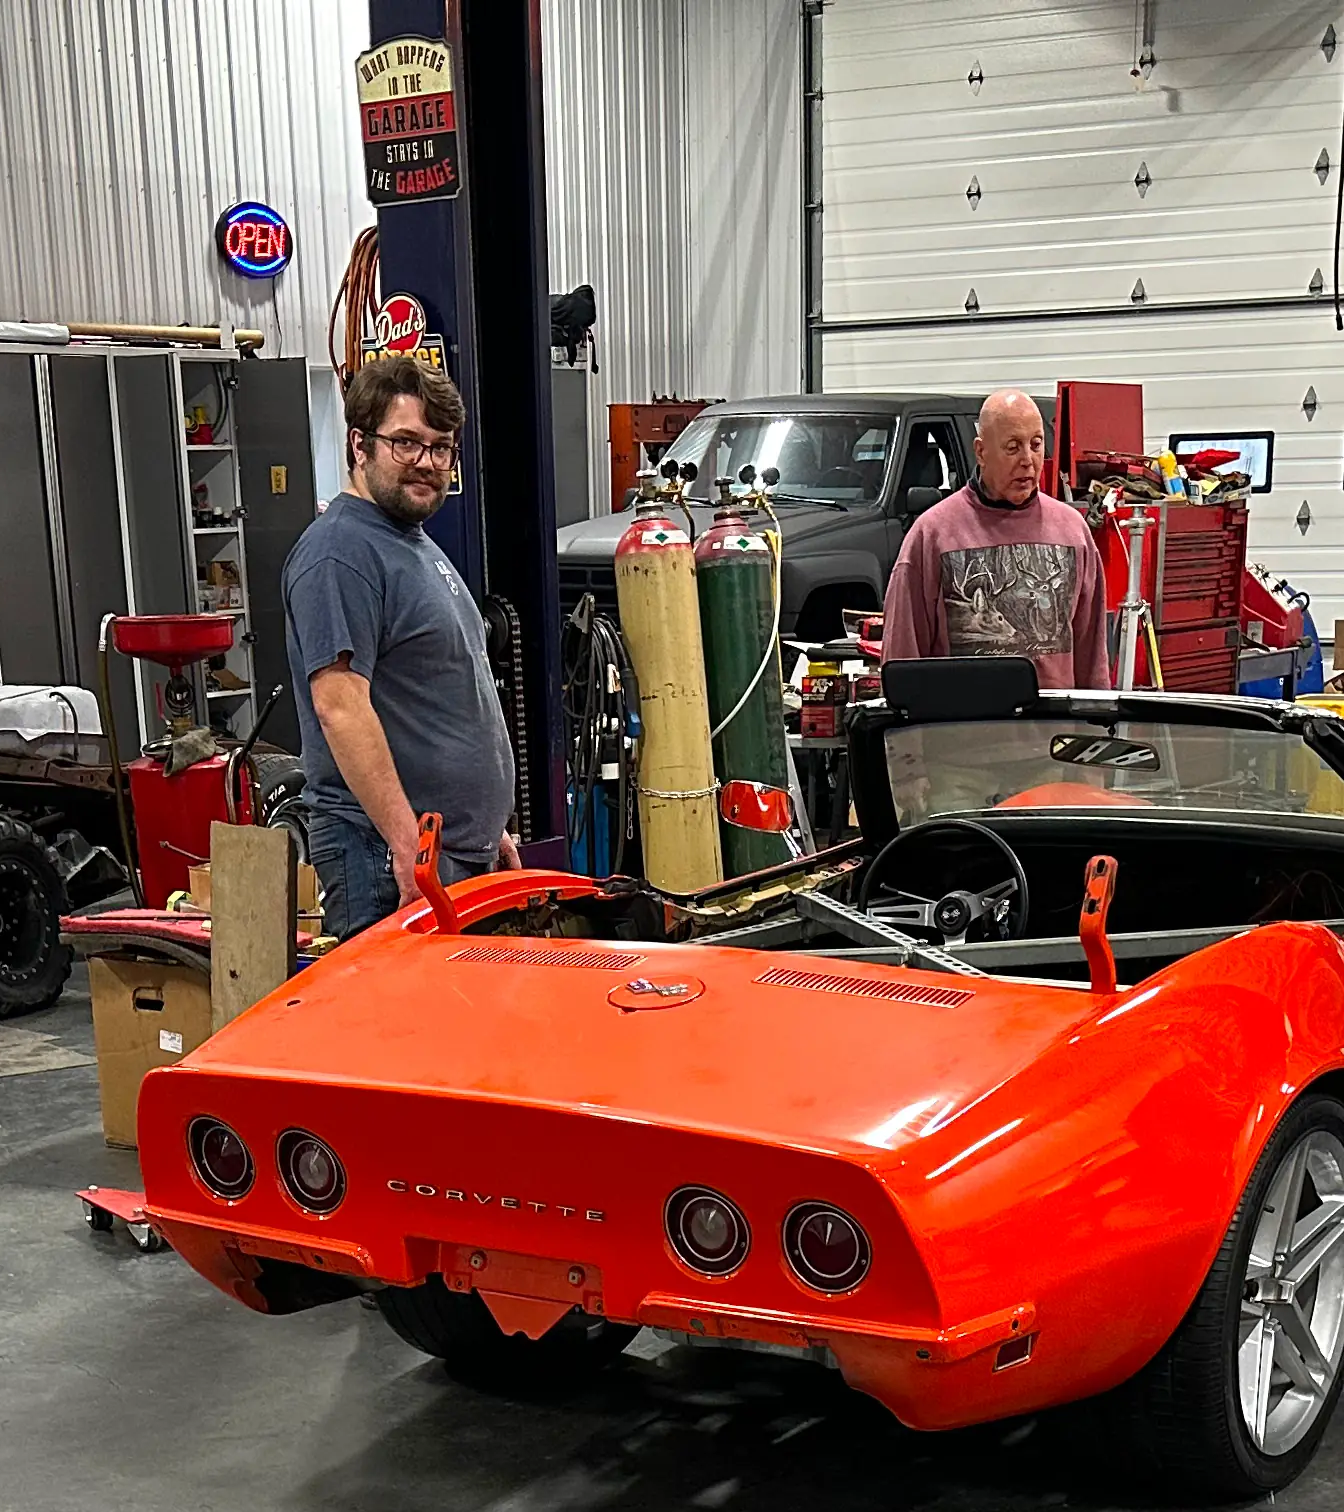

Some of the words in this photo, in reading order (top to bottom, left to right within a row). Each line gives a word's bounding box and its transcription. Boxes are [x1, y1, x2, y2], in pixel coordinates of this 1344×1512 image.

[360, 50, 391, 83] WHAT
[396, 46, 446, 73] HAPPENS
[388, 77, 398, 96] IN
[402, 73, 422, 94] THE
[367, 99, 446, 137] GARAGE
[386, 141, 419, 164] STAYS
[423, 139, 434, 159] IN
[370, 168, 391, 191] THE
[395, 158, 456, 195] GARAGE
[225, 221, 286, 258] OPEN
[375, 303, 426, 348] Dad's
[386, 1179, 604, 1222] CORVETTE
